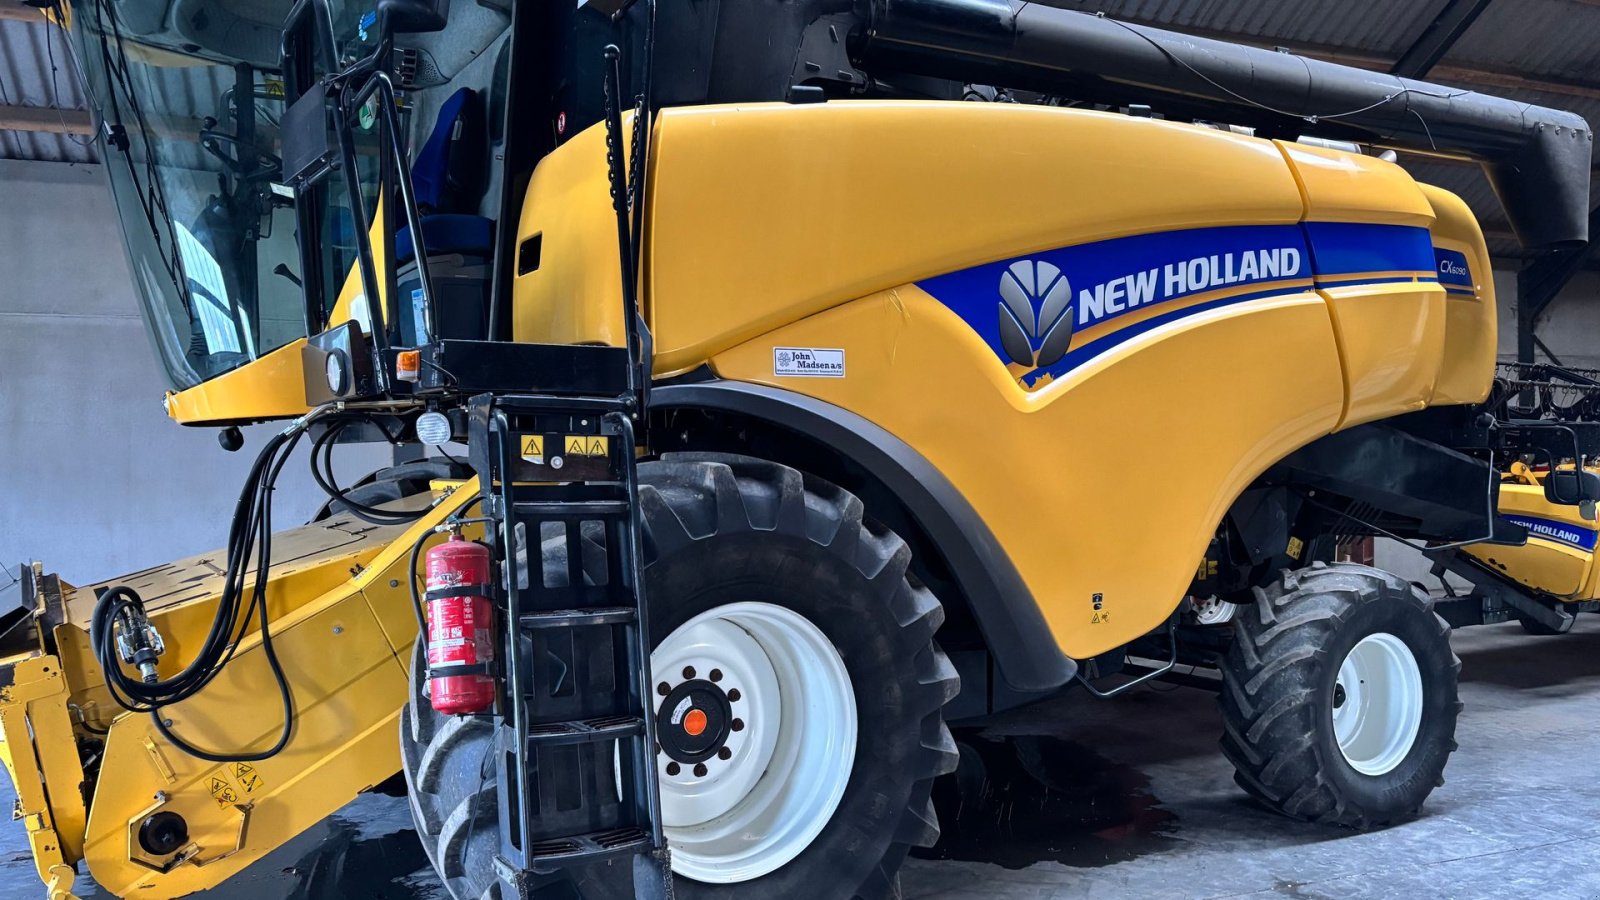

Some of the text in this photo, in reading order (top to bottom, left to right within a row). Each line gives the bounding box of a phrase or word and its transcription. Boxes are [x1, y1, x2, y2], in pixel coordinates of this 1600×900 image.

[1079, 248, 1300, 325] NEW HOLLAND
[792, 352, 810, 361] John
[797, 361, 829, 369] Madsen
[1534, 524, 1580, 543] HOLLAND
